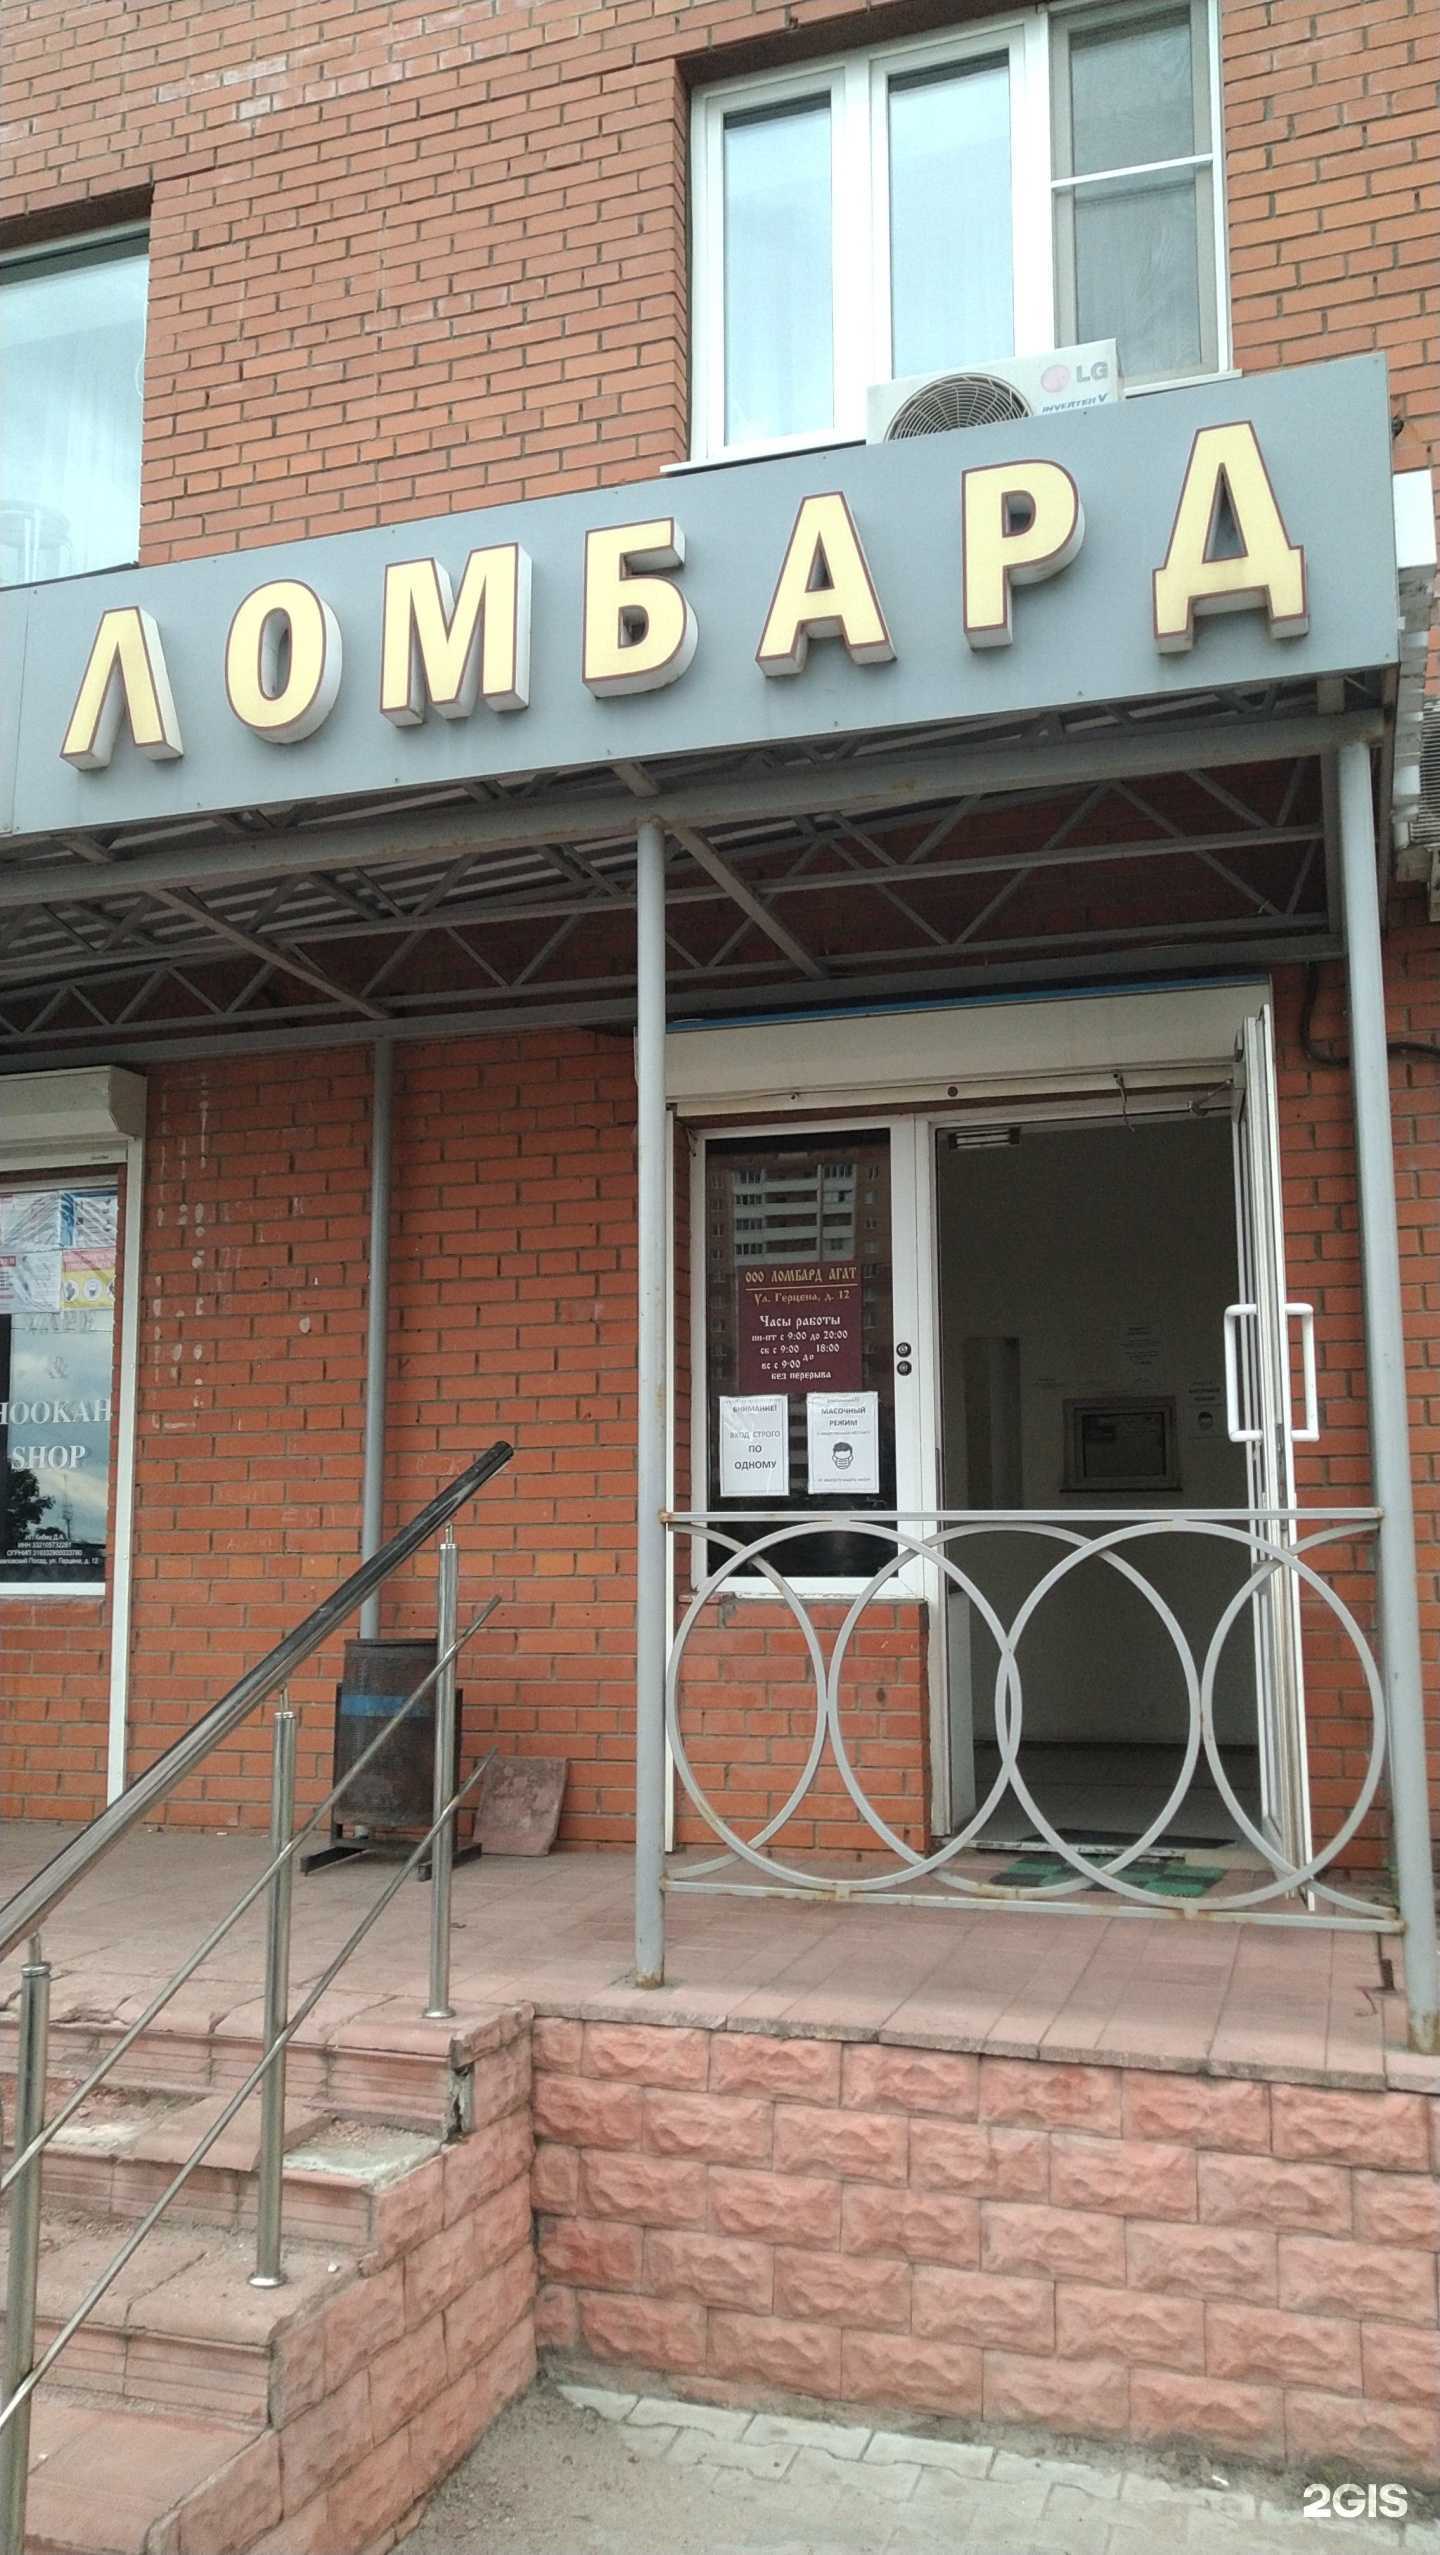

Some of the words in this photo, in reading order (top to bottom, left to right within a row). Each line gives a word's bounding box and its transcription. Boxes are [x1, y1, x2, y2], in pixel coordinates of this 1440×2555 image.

[1076, 361, 1108, 383] LG
[60, 420, 1309, 771] ЛОМБАРД
[745, 1271, 765, 1283] ООО
[771, 1268, 823, 1283] ЛОМБАРД
[828, 1266, 857, 1280] АГАТ
[839, 1290, 850, 1299] 12
[760, 1315, 791, 1327] Часы
[796, 1316, 840, 1330] работы
[787, 1331, 807, 1340] 9:00
[823, 1330, 848, 1340] 20:00
[780, 1345, 800, 1353] 9:00
[816, 1343, 840, 1352] 18:00
[789, 1371, 832, 1381] перерыва
[821, 1406, 866, 1415] МАСОЧНЫЙ
[829, 1419, 858, 1427] РЕЖИМ
[752, 1430, 781, 1439] СТРОГО
[748, 1445, 762, 1454] ПО
[11, 1445, 86, 1471] SHOP
[734, 1460, 777, 1471] ОДНОМУ
